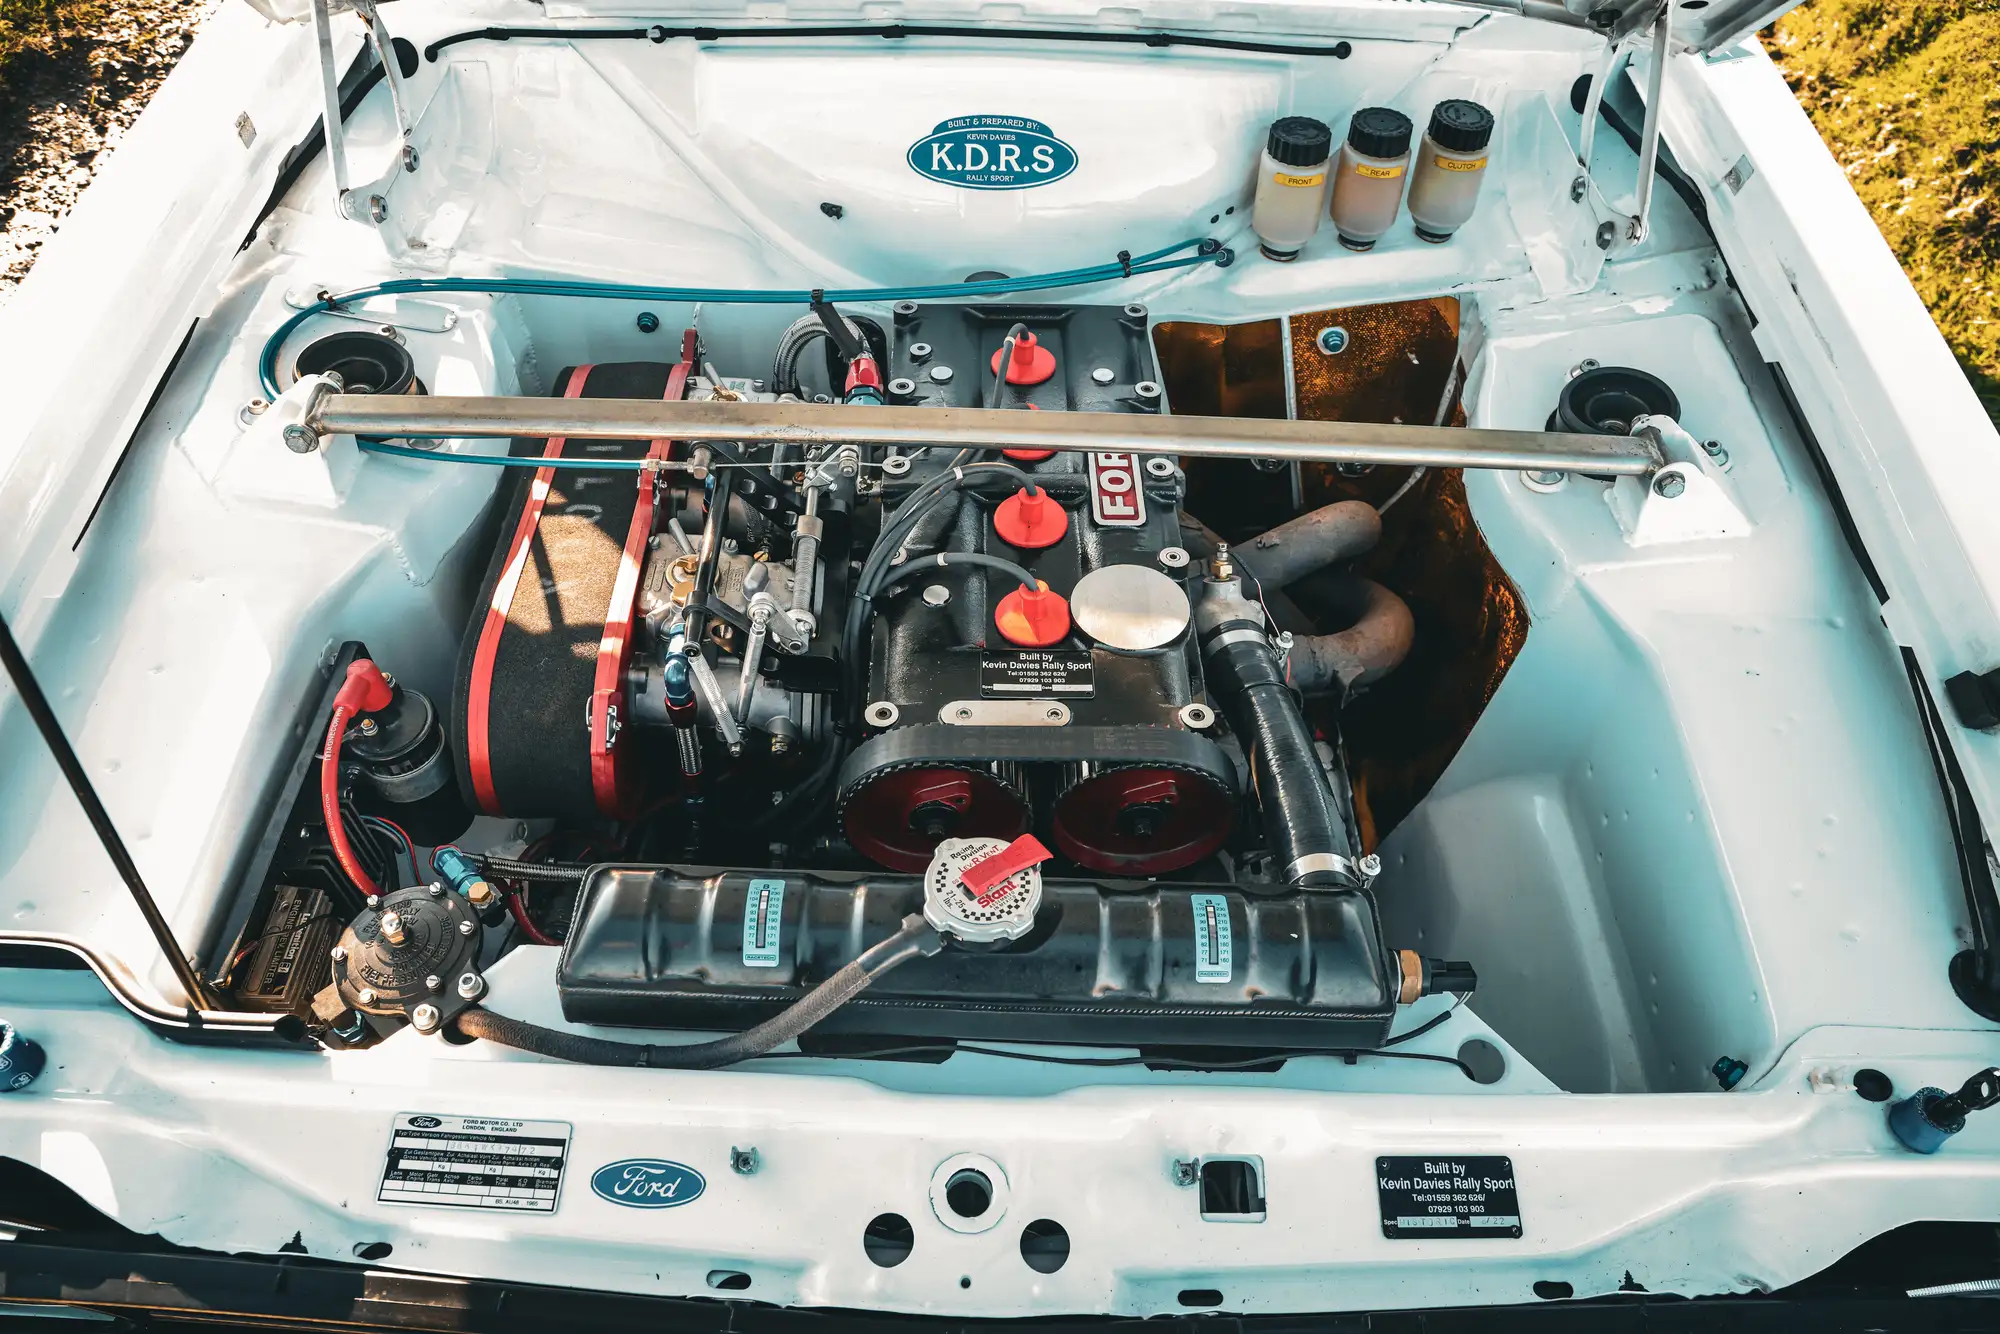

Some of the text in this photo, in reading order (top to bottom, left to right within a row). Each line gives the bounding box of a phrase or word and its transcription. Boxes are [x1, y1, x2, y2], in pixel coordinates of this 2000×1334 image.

[948, 118, 970, 128] BUILT
[982, 118, 1024, 128] PREPARED
[1026, 122, 1040, 130] BY:
[931, 143, 1055, 173] K.D.R.S
[1448, 162, 1476, 170] CLUTCH
[1096, 452, 1135, 516] FOR
[1020, 652, 1054, 662] Built by
[1010, 661, 1040, 669] Davies
[1042, 661, 1064, 671] Rally
[1066, 662, 1092, 670] Sport
[950, 844, 975, 860] Racing
[961, 843, 988, 861] Division
[977, 880, 1017, 908] Stant
[284, 899, 302, 930] ENGINE
[264, 950, 281, 984] LIMITER
[414, 1117, 436, 1128] Ford
[1424, 1162, 1465, 1177] Built by
[614, 1165, 682, 1198] Ford
[1380, 1178, 1514, 1192] Kevin Davies Rally Sport
